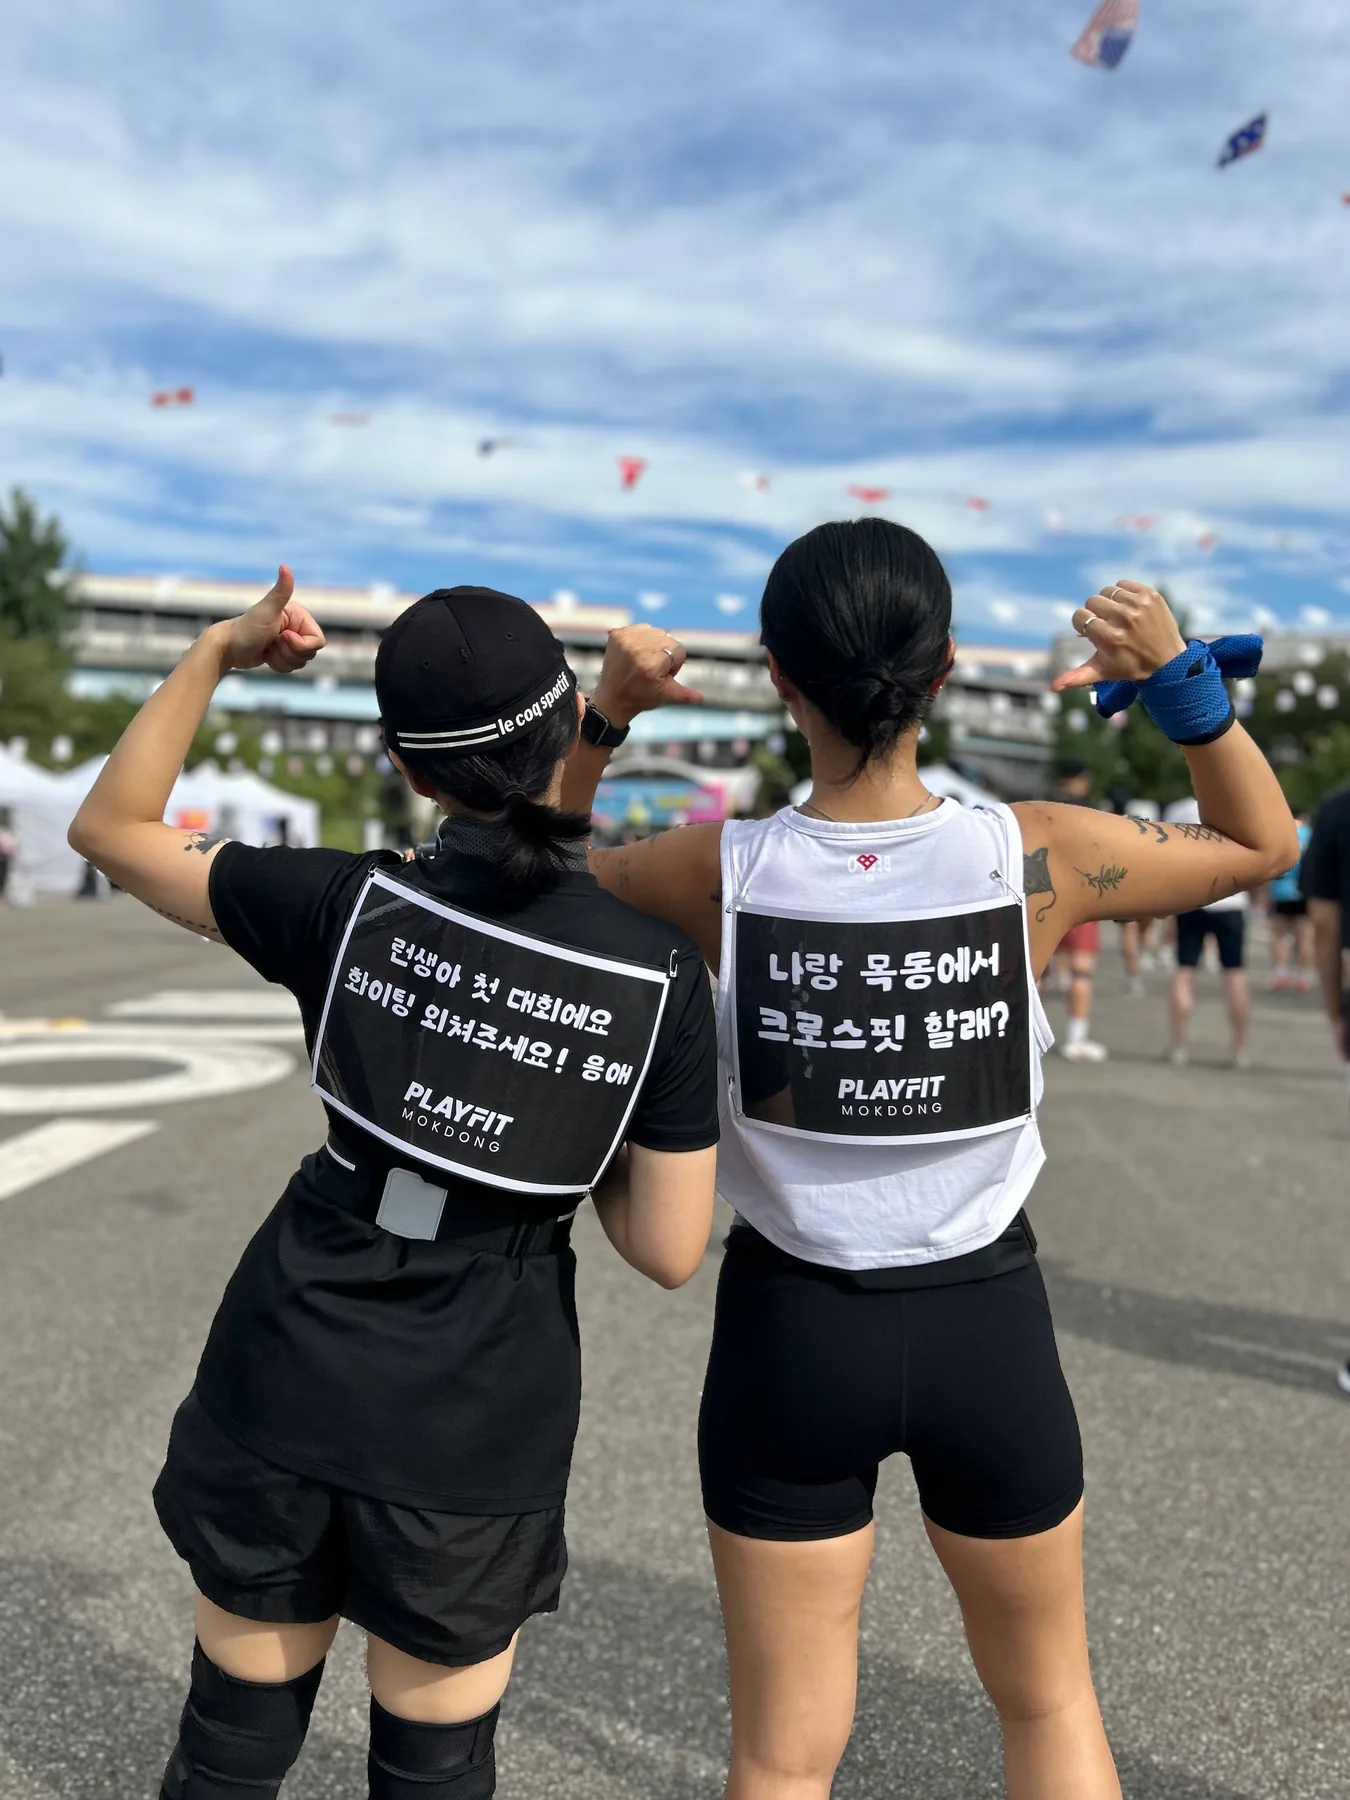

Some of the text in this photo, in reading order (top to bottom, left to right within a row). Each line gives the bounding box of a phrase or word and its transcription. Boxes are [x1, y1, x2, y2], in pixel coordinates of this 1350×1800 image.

[498, 671, 570, 736] le coq sportif
[390, 937, 613, 1036] 런생아 첫 대회에요
[769, 942, 999, 992] 나랑 목동에서
[344, 966, 634, 1086] 화이팅 외쳐주세요! 응애
[758, 1000, 1009, 1053] 크로스핏 할래?
[403, 1081, 514, 1137] PLAYFIT
[838, 1075, 946, 1099] PLAYFIT
[841, 1102, 942, 1117] MOKDONG
[402, 1107, 500, 1153] MOKDONG
